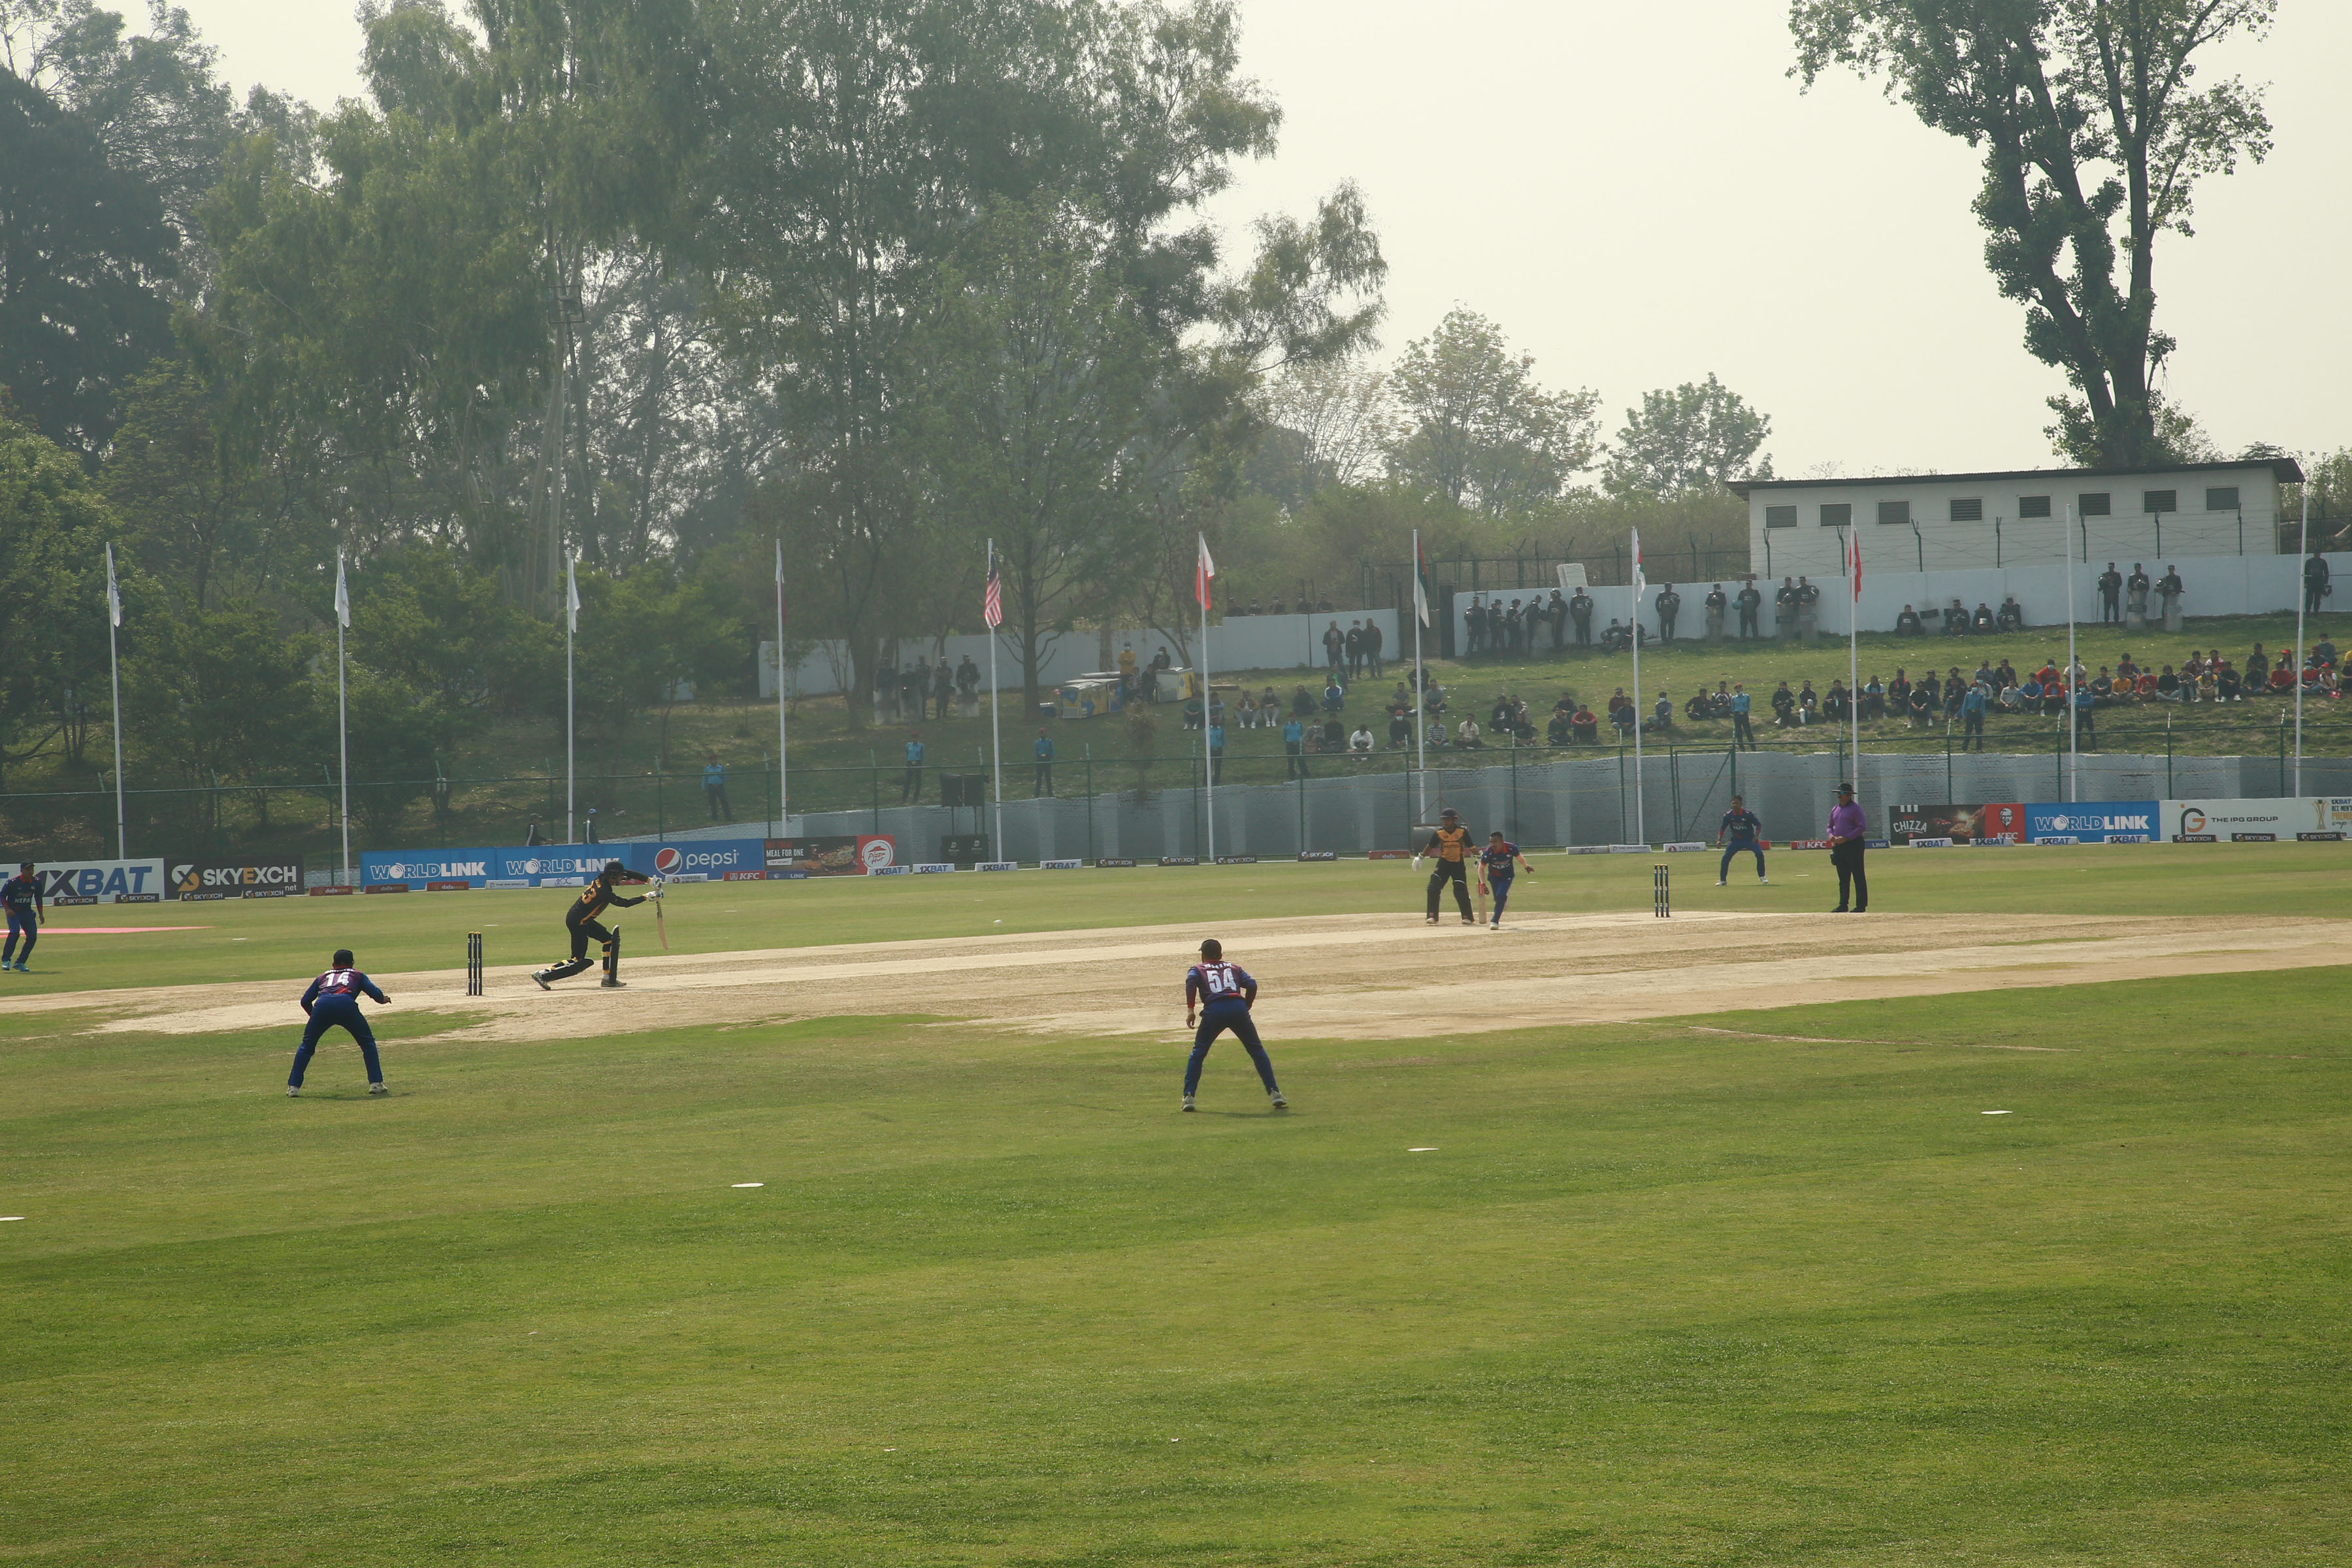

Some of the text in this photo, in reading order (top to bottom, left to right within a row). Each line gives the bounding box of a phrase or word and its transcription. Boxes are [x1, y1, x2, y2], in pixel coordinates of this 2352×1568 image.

[1893, 820, 1927, 832] CHIZZA
[2034, 815, 2149, 831] WORLDLINK
[686, 849, 737, 870] pepsi
[868, 852, 885, 860] Pizza
[203, 866, 297, 886] SKYEXCH
[370, 862, 486, 880] WORLDLINK
[874, 867, 903, 875] 1XBAT
[326, 972, 350, 987] 14
[1206, 968, 1237, 993] 54
